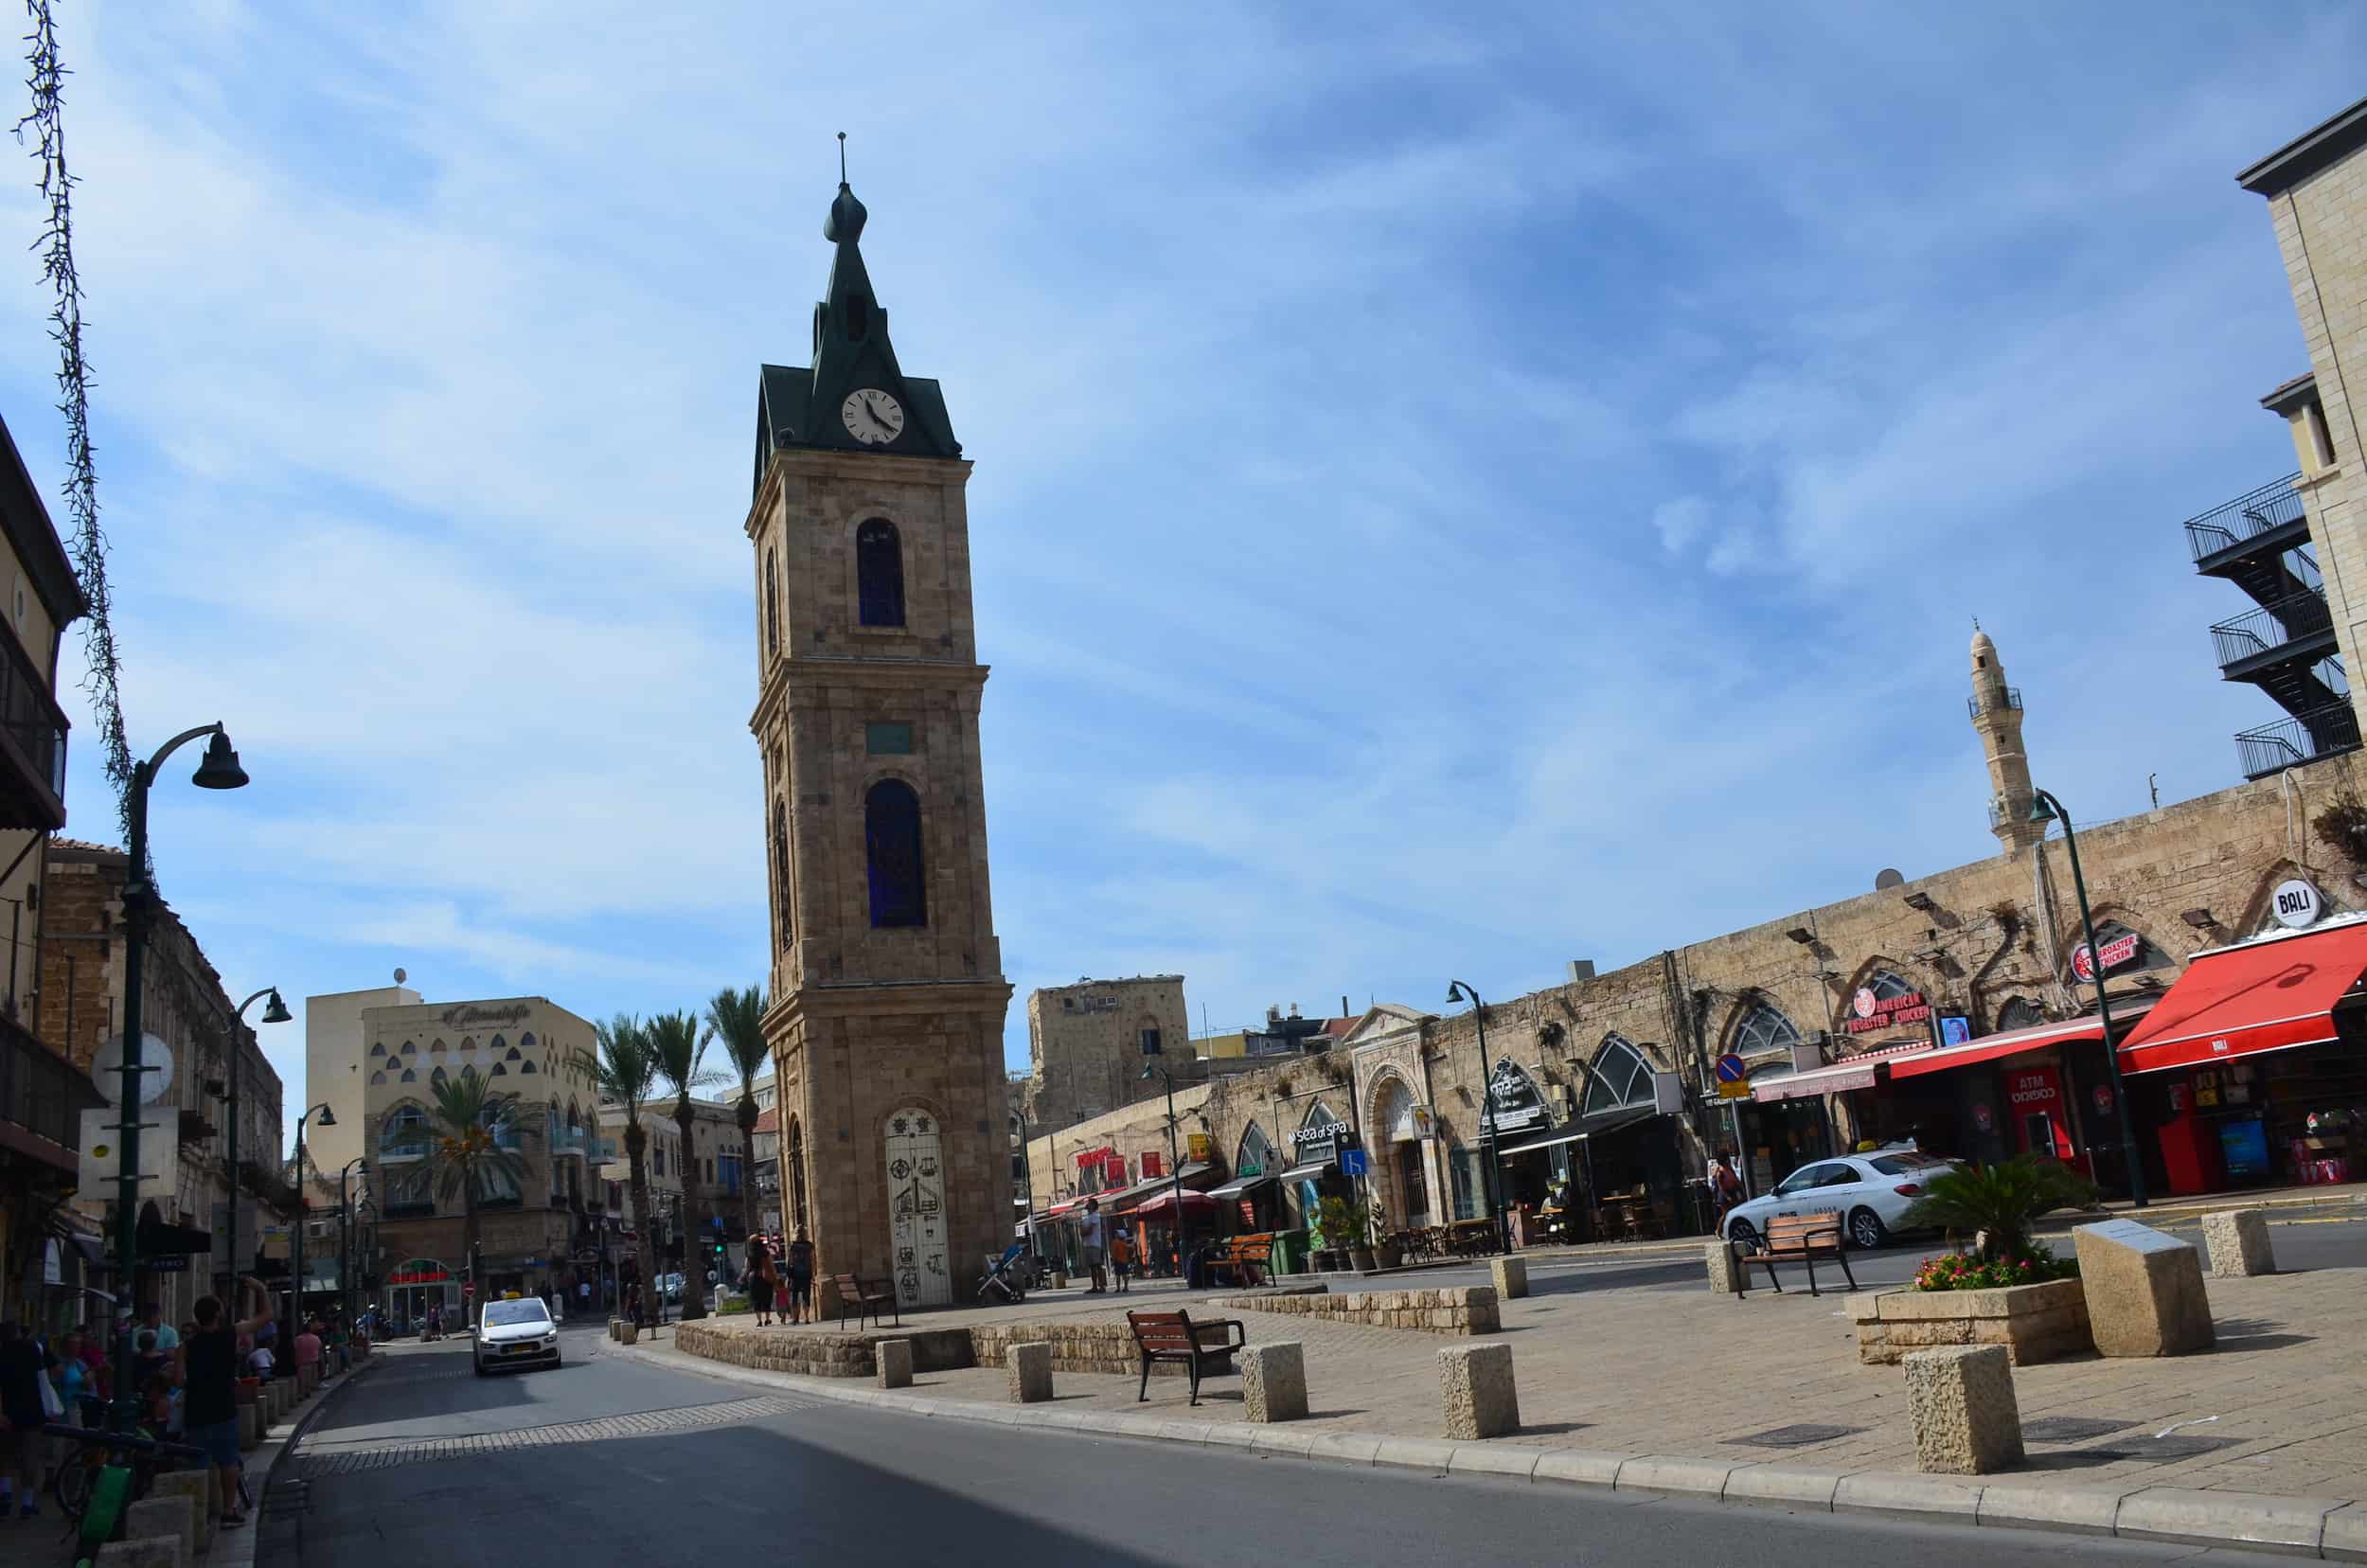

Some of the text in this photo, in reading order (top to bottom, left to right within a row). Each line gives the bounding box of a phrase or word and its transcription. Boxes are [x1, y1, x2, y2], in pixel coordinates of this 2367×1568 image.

[2278, 889, 2310, 914] BALI
[1877, 991, 1921, 1012] AMERICAN
[1895, 1005, 1930, 1023] CHICKEN
[2020, 1075, 2044, 1089] ATM
[1296, 1121, 1347, 1142] sea of spa
